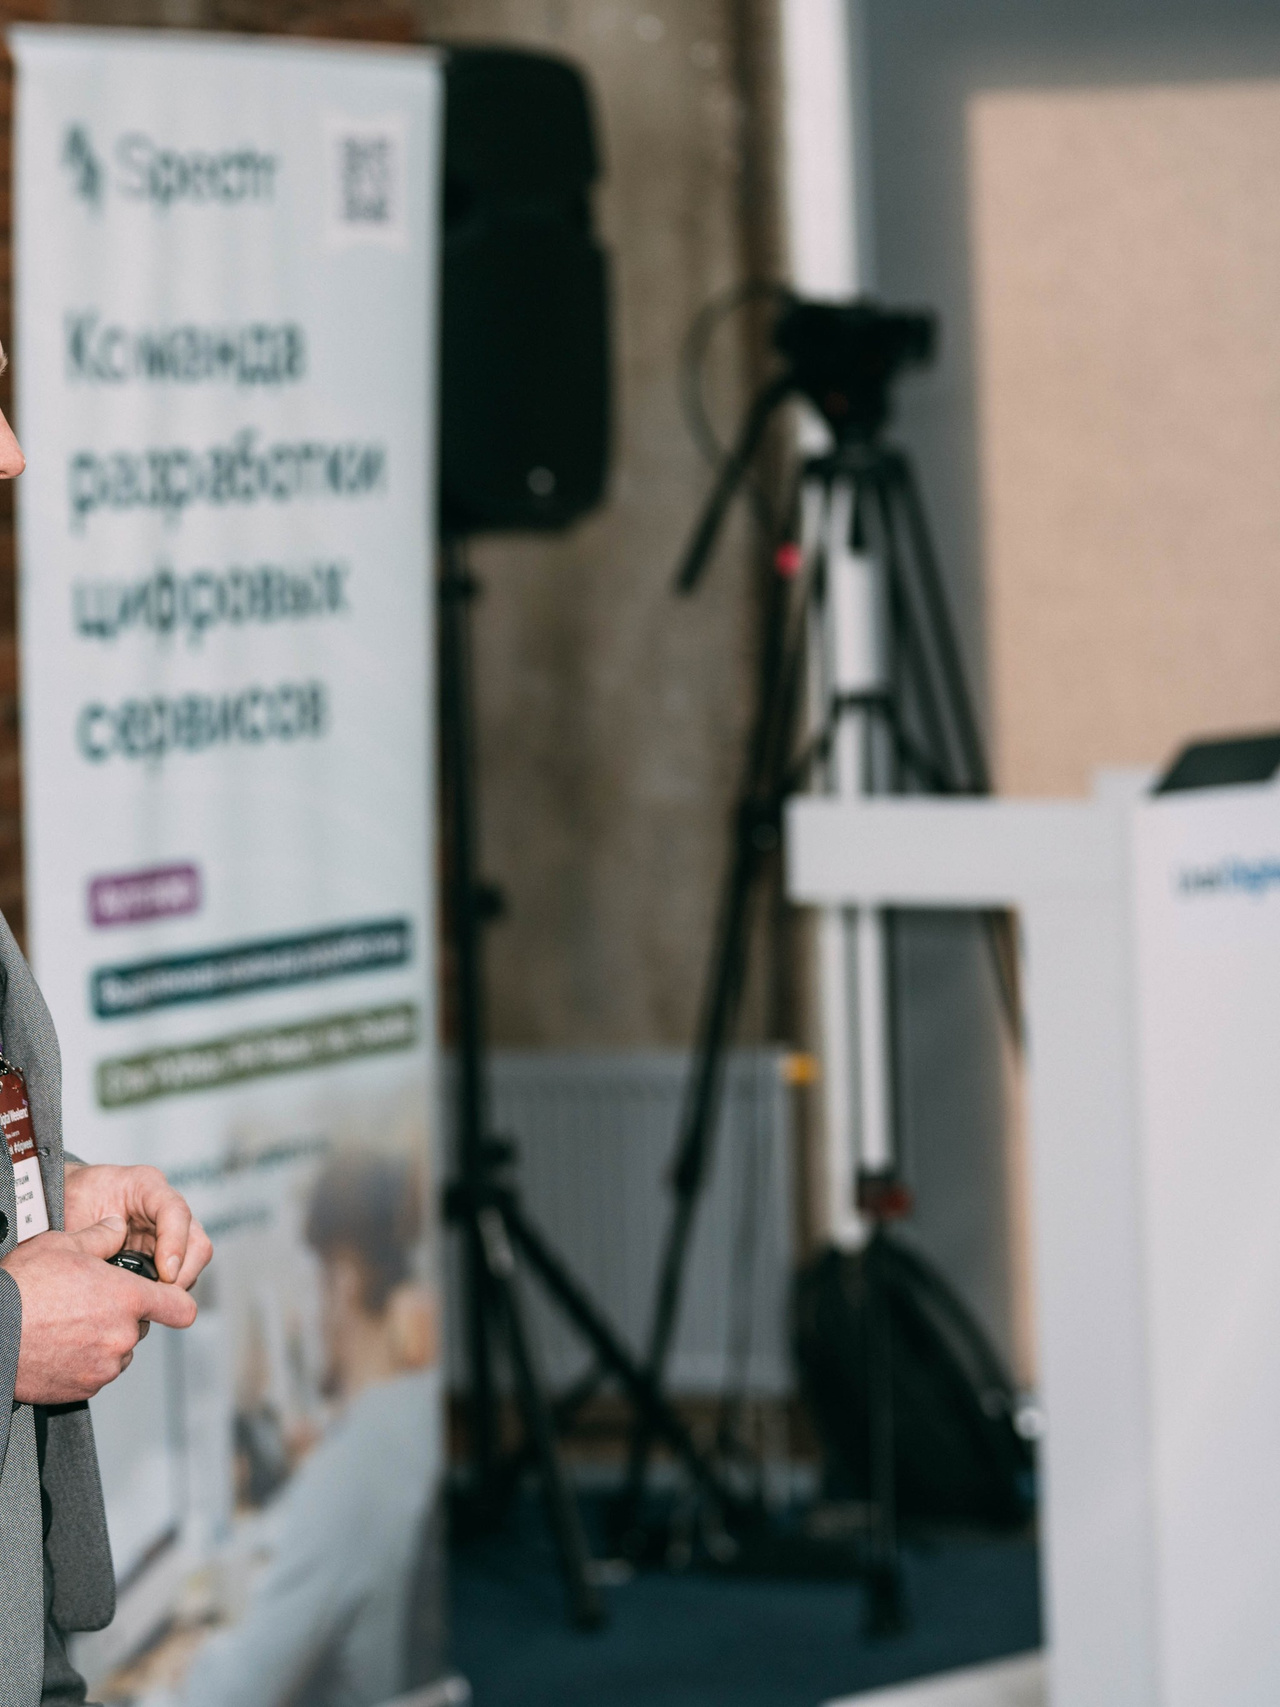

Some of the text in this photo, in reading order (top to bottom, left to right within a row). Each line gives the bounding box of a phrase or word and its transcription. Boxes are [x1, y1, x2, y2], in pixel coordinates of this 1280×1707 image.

[118, 136, 277, 211] Spectr
[66, 312, 305, 387] Команда
[69, 428, 385, 530] разработки
[73, 562, 346, 649] цифровых
[77, 680, 328, 773] сервисов
